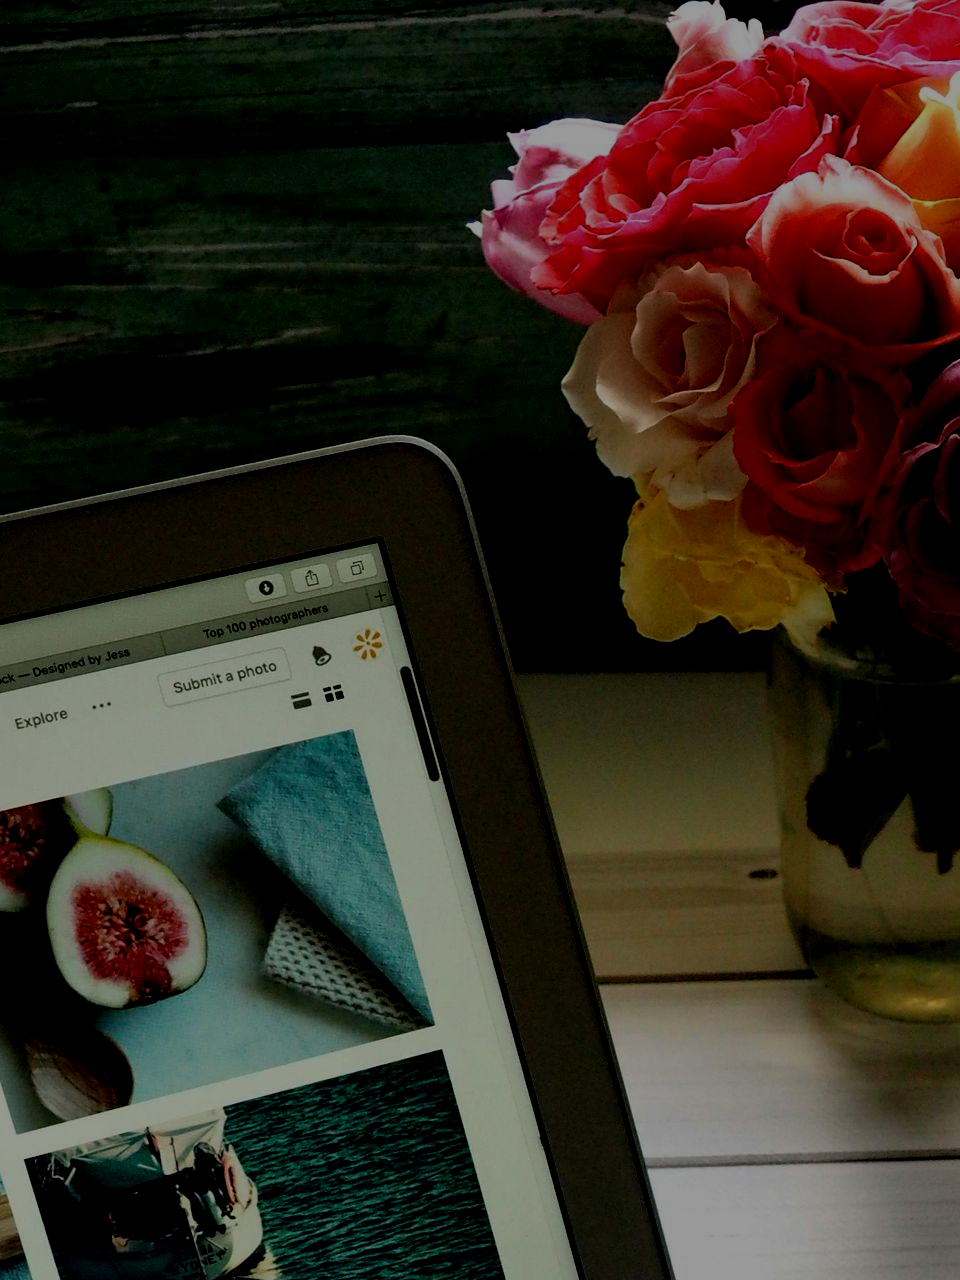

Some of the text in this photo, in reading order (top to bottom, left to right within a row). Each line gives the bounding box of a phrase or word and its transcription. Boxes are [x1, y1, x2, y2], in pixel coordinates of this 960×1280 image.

[202, 603, 329, 641] Top 100 photographers
[32, 657, 86, 677] Designed
[88, 653, 102, 666] by
[105, 646, 131, 662] Jess
[173, 659, 277, 695] Submit a photo
[14, 708, 68, 730] Explore
